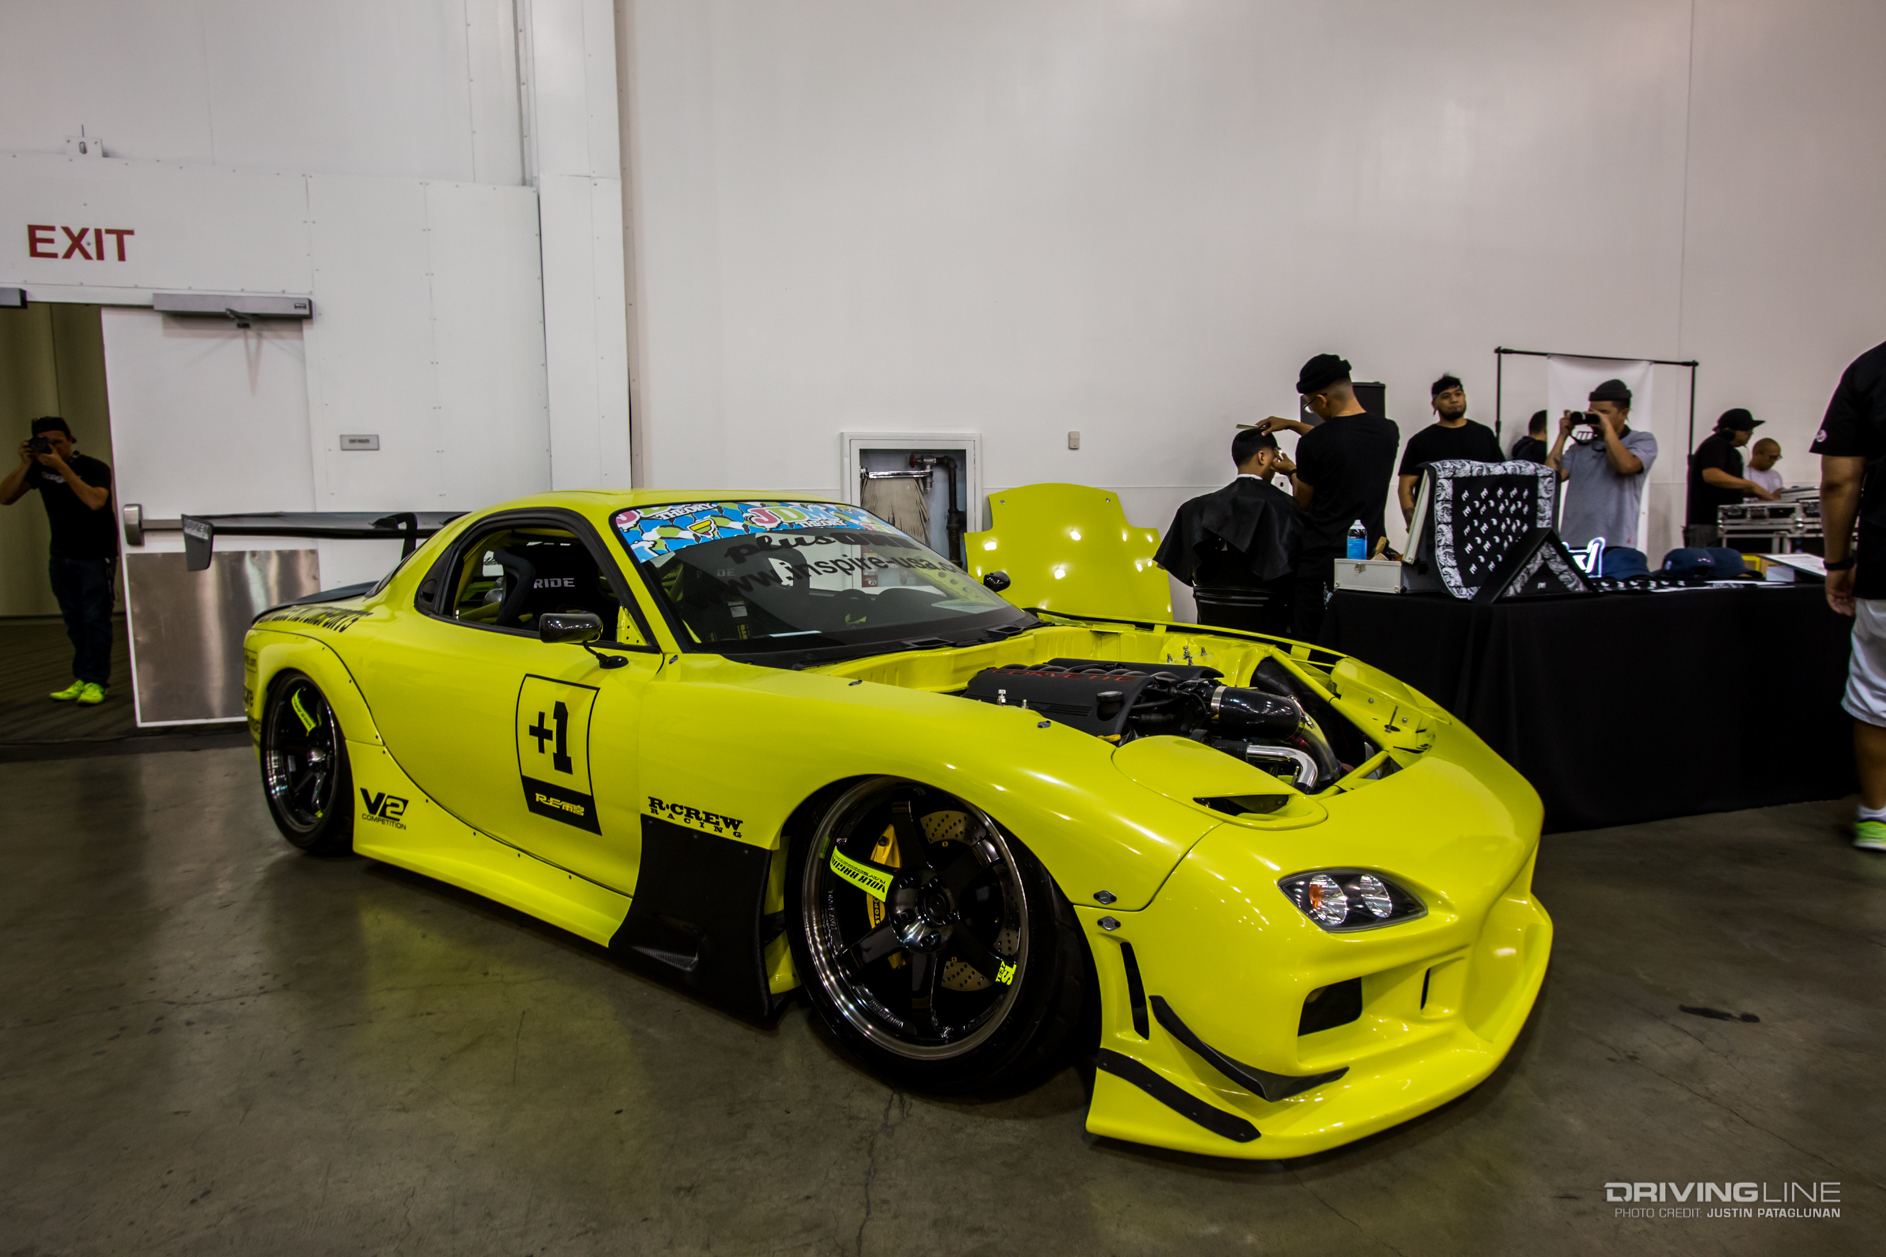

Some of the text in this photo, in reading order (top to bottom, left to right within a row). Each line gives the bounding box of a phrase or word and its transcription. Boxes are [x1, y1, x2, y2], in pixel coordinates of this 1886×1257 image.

[27, 224, 135, 262] EXIT
[656, 502, 714, 521] THEORY
[749, 506, 838, 524] JDM
[991, 668, 1137, 682] CORVETTE
[529, 700, 573, 775] +1
[360, 787, 409, 822] V2
[361, 813, 407, 831] COMPETITION
[650, 807, 743, 839] RACING
